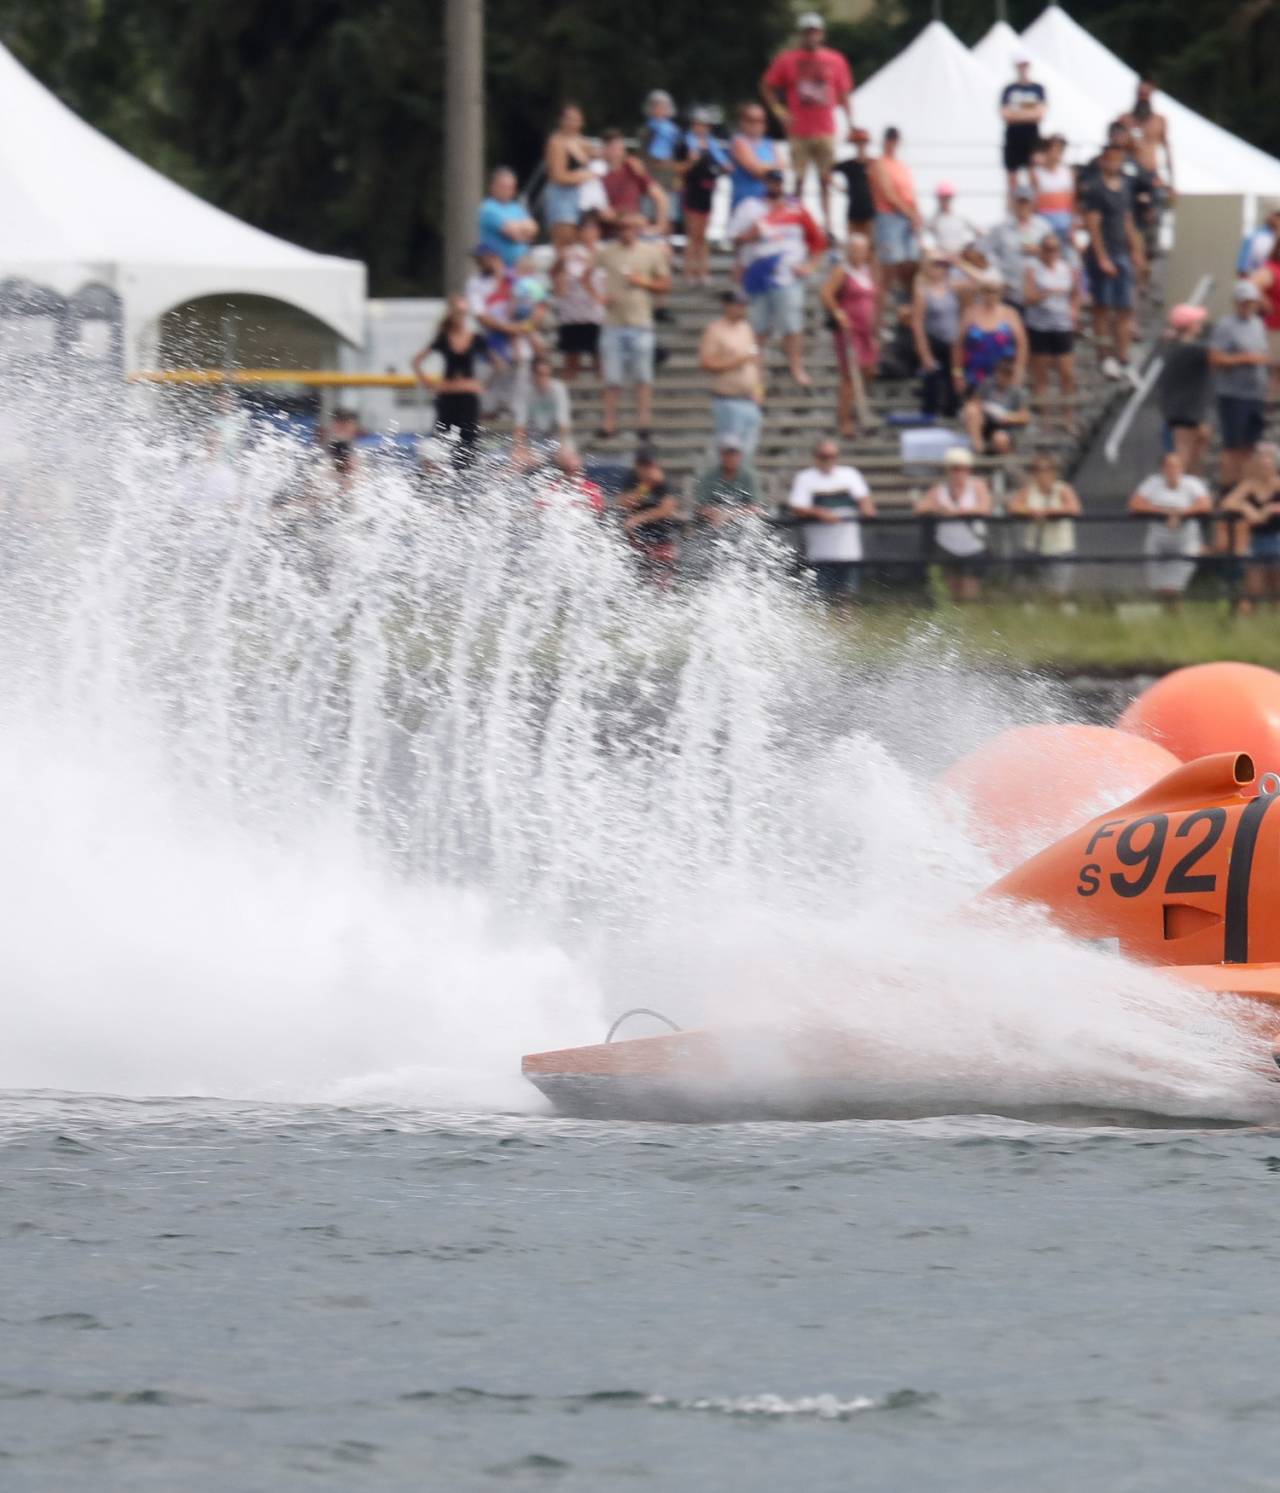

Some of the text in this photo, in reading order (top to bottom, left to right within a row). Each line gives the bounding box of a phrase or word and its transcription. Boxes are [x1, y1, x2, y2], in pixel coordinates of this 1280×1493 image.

[1085, 819, 1126, 856] F
[1109, 807, 1227, 898] 92
[1076, 863, 1103, 897] S
